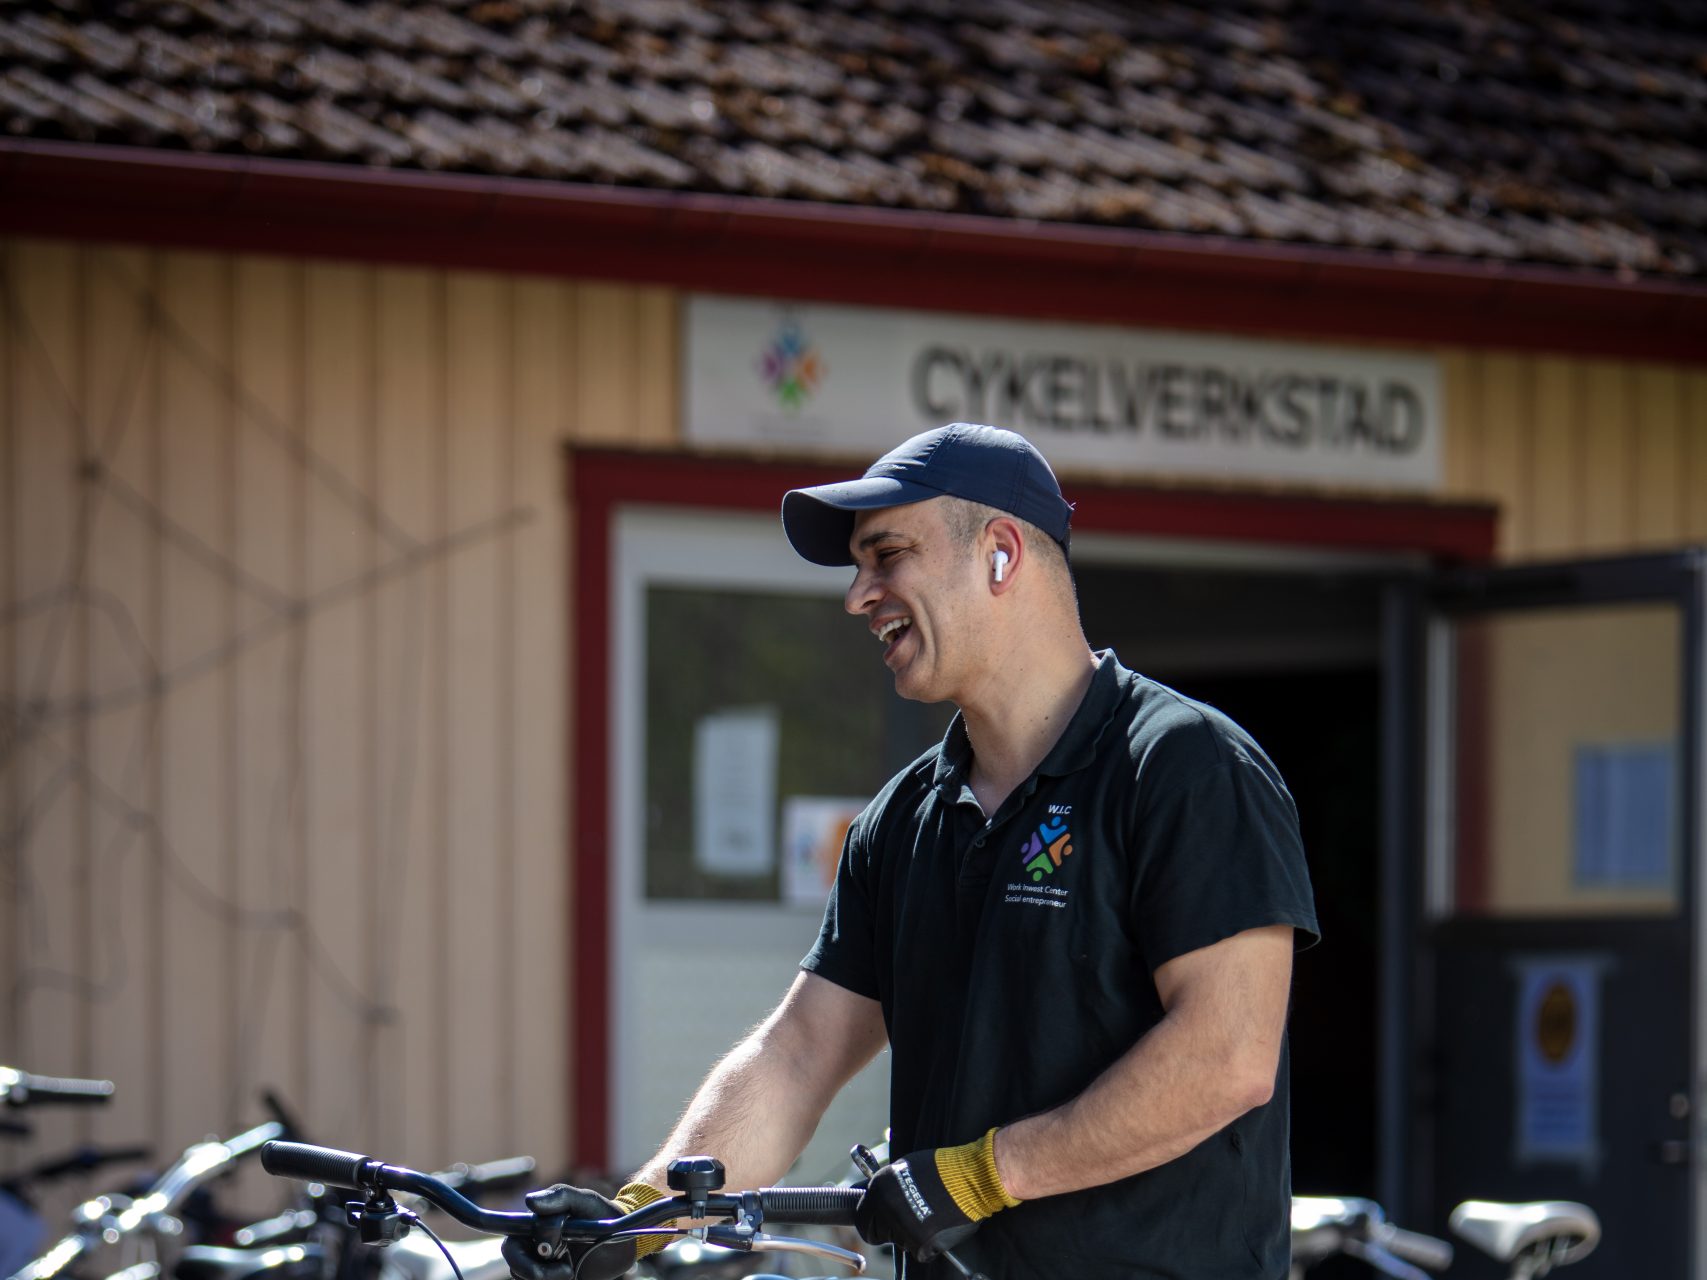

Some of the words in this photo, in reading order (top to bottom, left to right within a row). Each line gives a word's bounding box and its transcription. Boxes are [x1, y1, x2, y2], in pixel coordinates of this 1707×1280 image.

[911, 342, 1424, 455] CYKELVERKSTAD
[1004, 894, 1022, 902] Social
[1007, 883, 1022, 891] Work
[1045, 886, 1068, 896] Center
[902, 1168, 929, 1215] TEGERA
